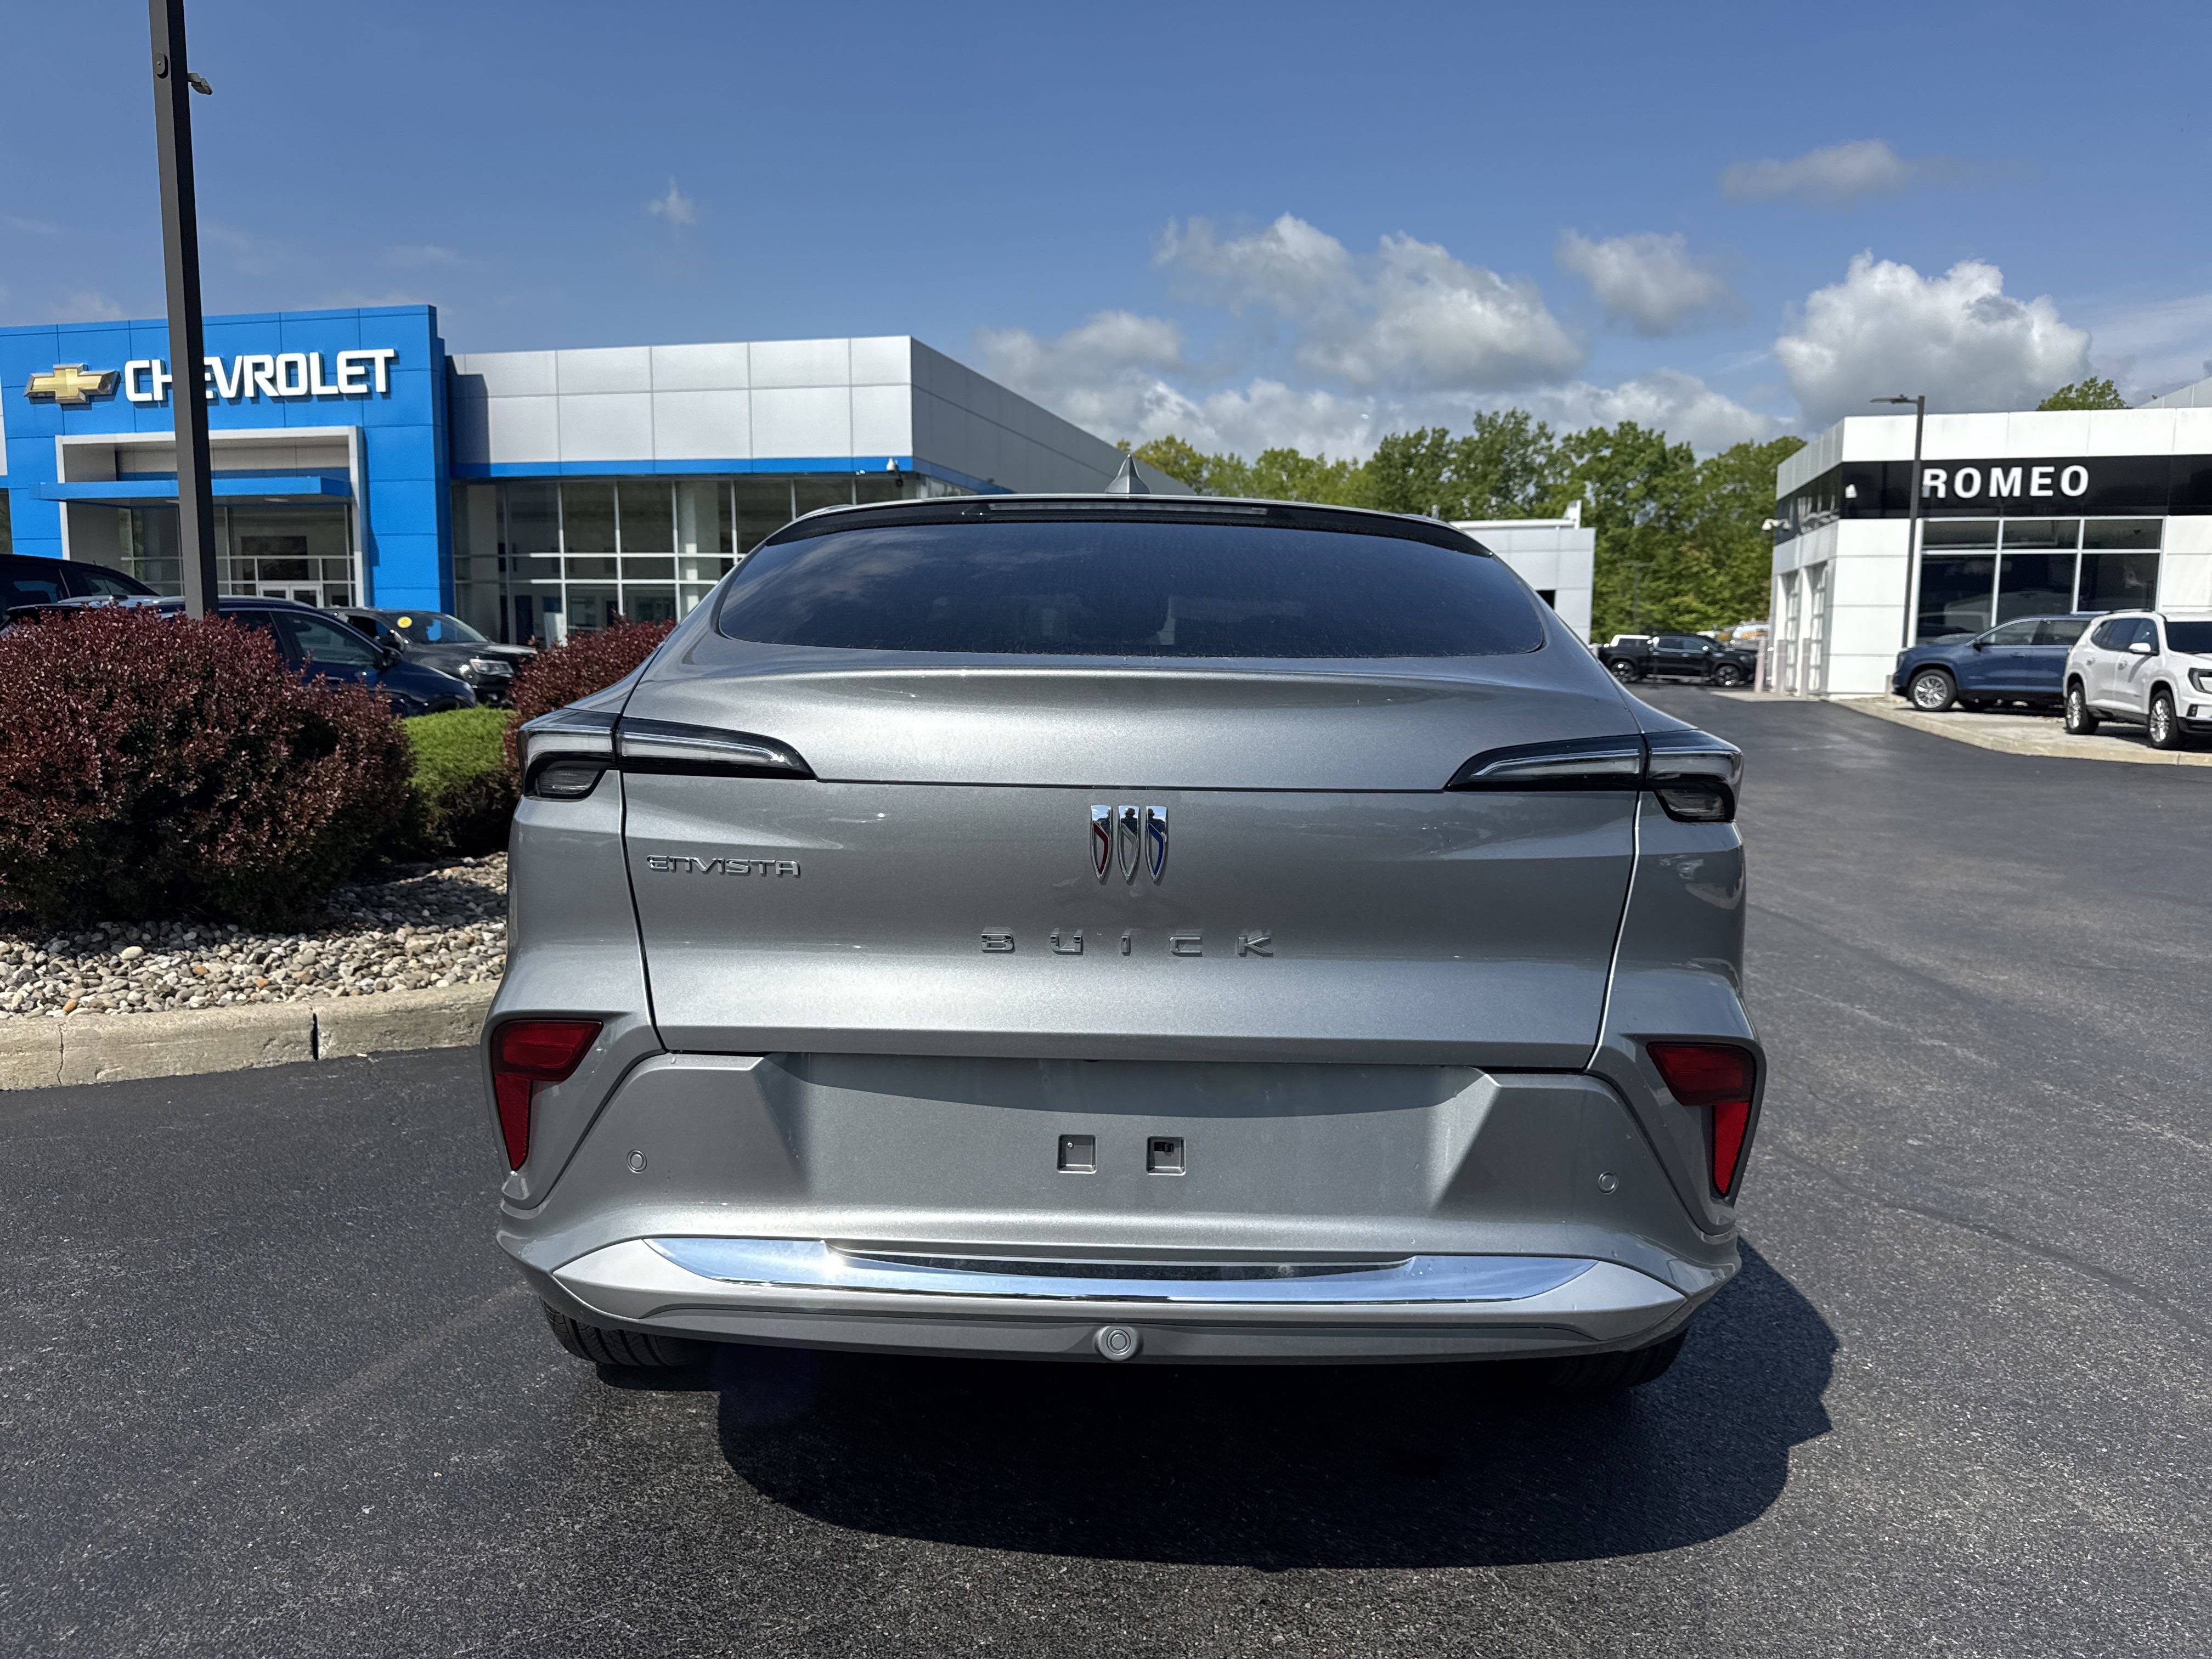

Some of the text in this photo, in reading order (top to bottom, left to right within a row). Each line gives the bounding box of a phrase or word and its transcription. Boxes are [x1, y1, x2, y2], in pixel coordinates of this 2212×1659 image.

[1922, 465, 2089, 498] ROMEO
[646, 855, 801, 876] ENVISTA
[981, 933, 1273, 957] BUICK
